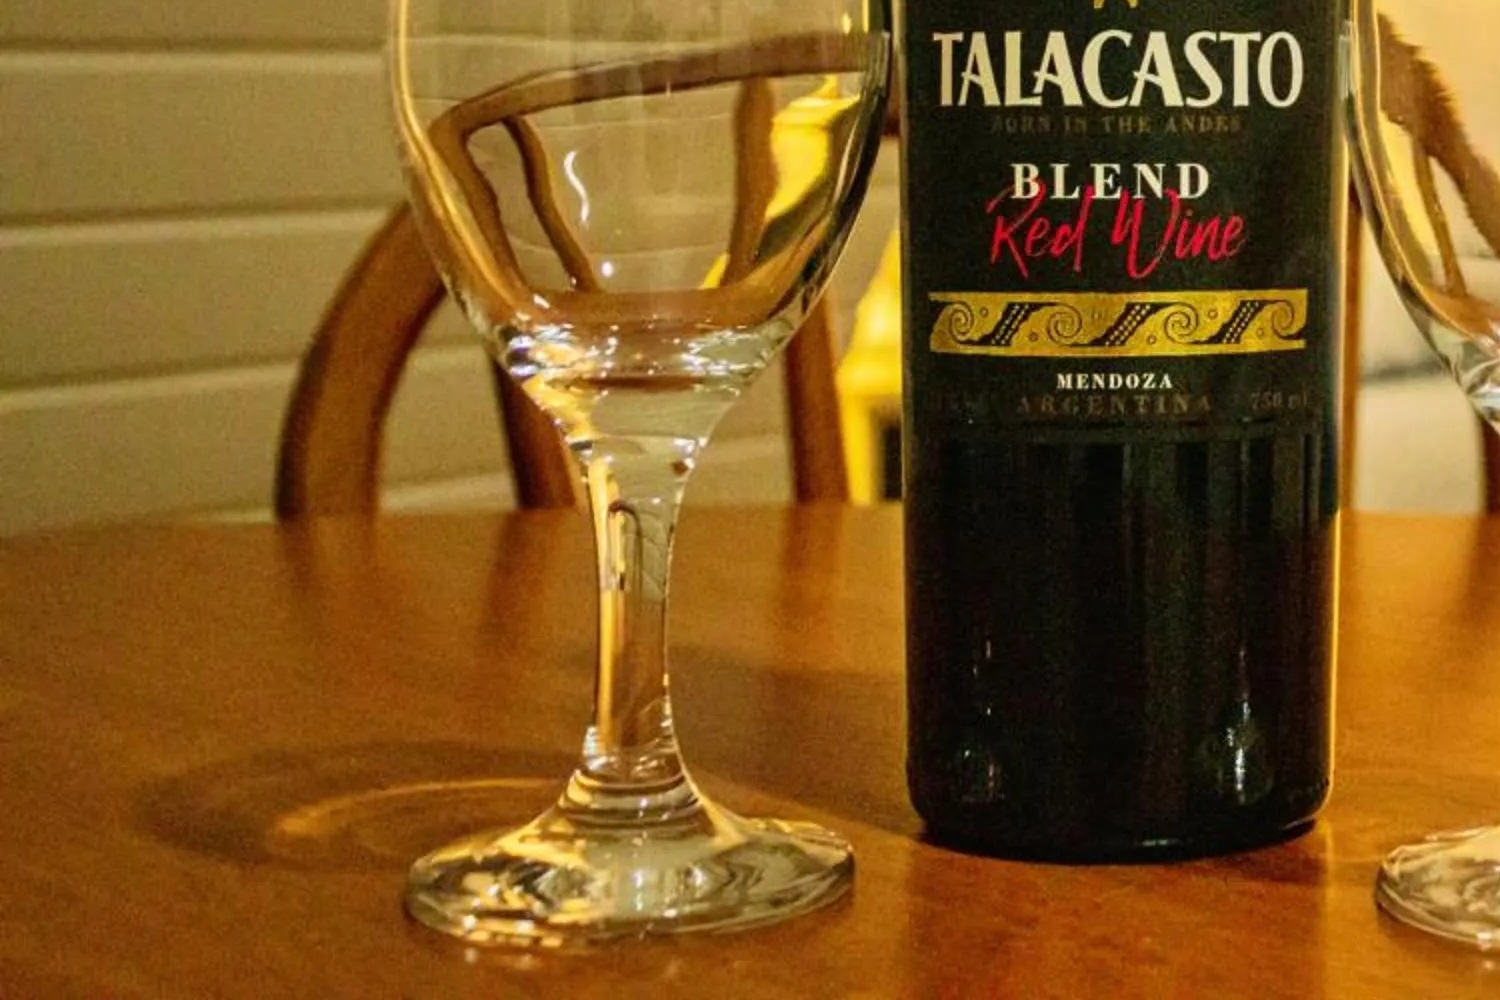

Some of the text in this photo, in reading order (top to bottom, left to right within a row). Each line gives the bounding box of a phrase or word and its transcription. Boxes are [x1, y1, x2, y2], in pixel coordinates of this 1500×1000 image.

[932, 29, 1304, 107] TALACASTO
[1102, 114, 1152, 133] THE
[1165, 114, 1242, 133] ANDES
[1010, 162, 1211, 200] BLEND
[986, 178, 1247, 280] Red Wine
[1056, 372, 1173, 390] MENDOZA
[1016, 394, 1213, 416] ARGENTINA
